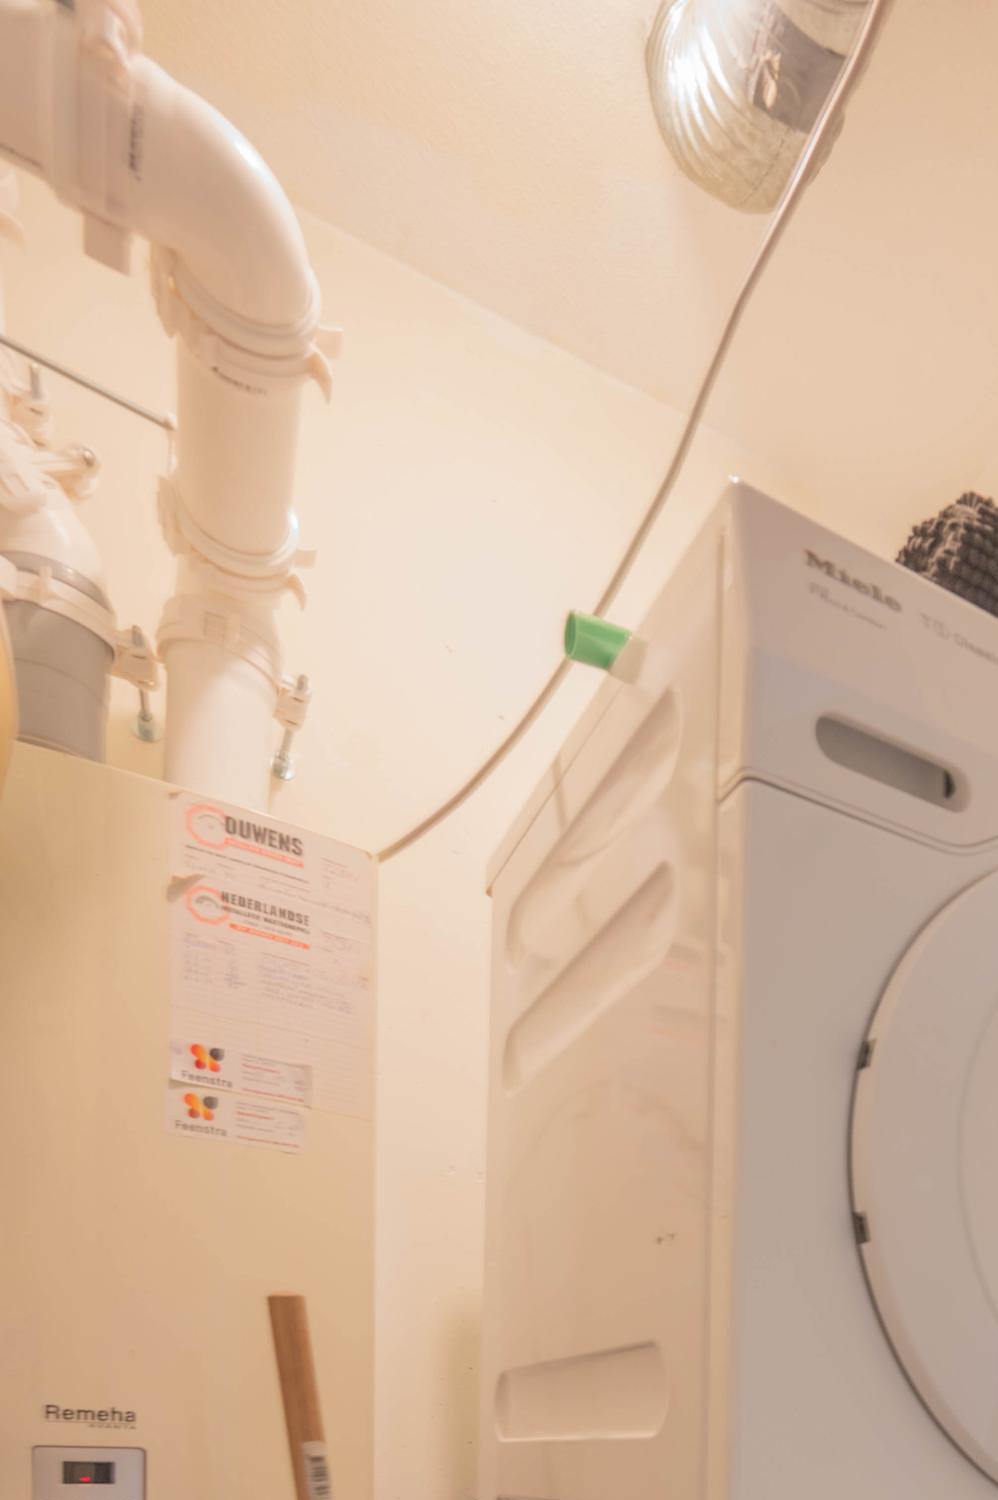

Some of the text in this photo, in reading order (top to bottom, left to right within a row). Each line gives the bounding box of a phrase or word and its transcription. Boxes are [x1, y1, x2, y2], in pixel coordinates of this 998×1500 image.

[803, 549, 902, 613] Miele
[220, 890, 311, 927] NEDERLANDSE
[181, 1069, 233, 1089] Feenstra
[174, 1119, 228, 1137] Feenstra
[45, 1404, 137, 1423] Remeha
